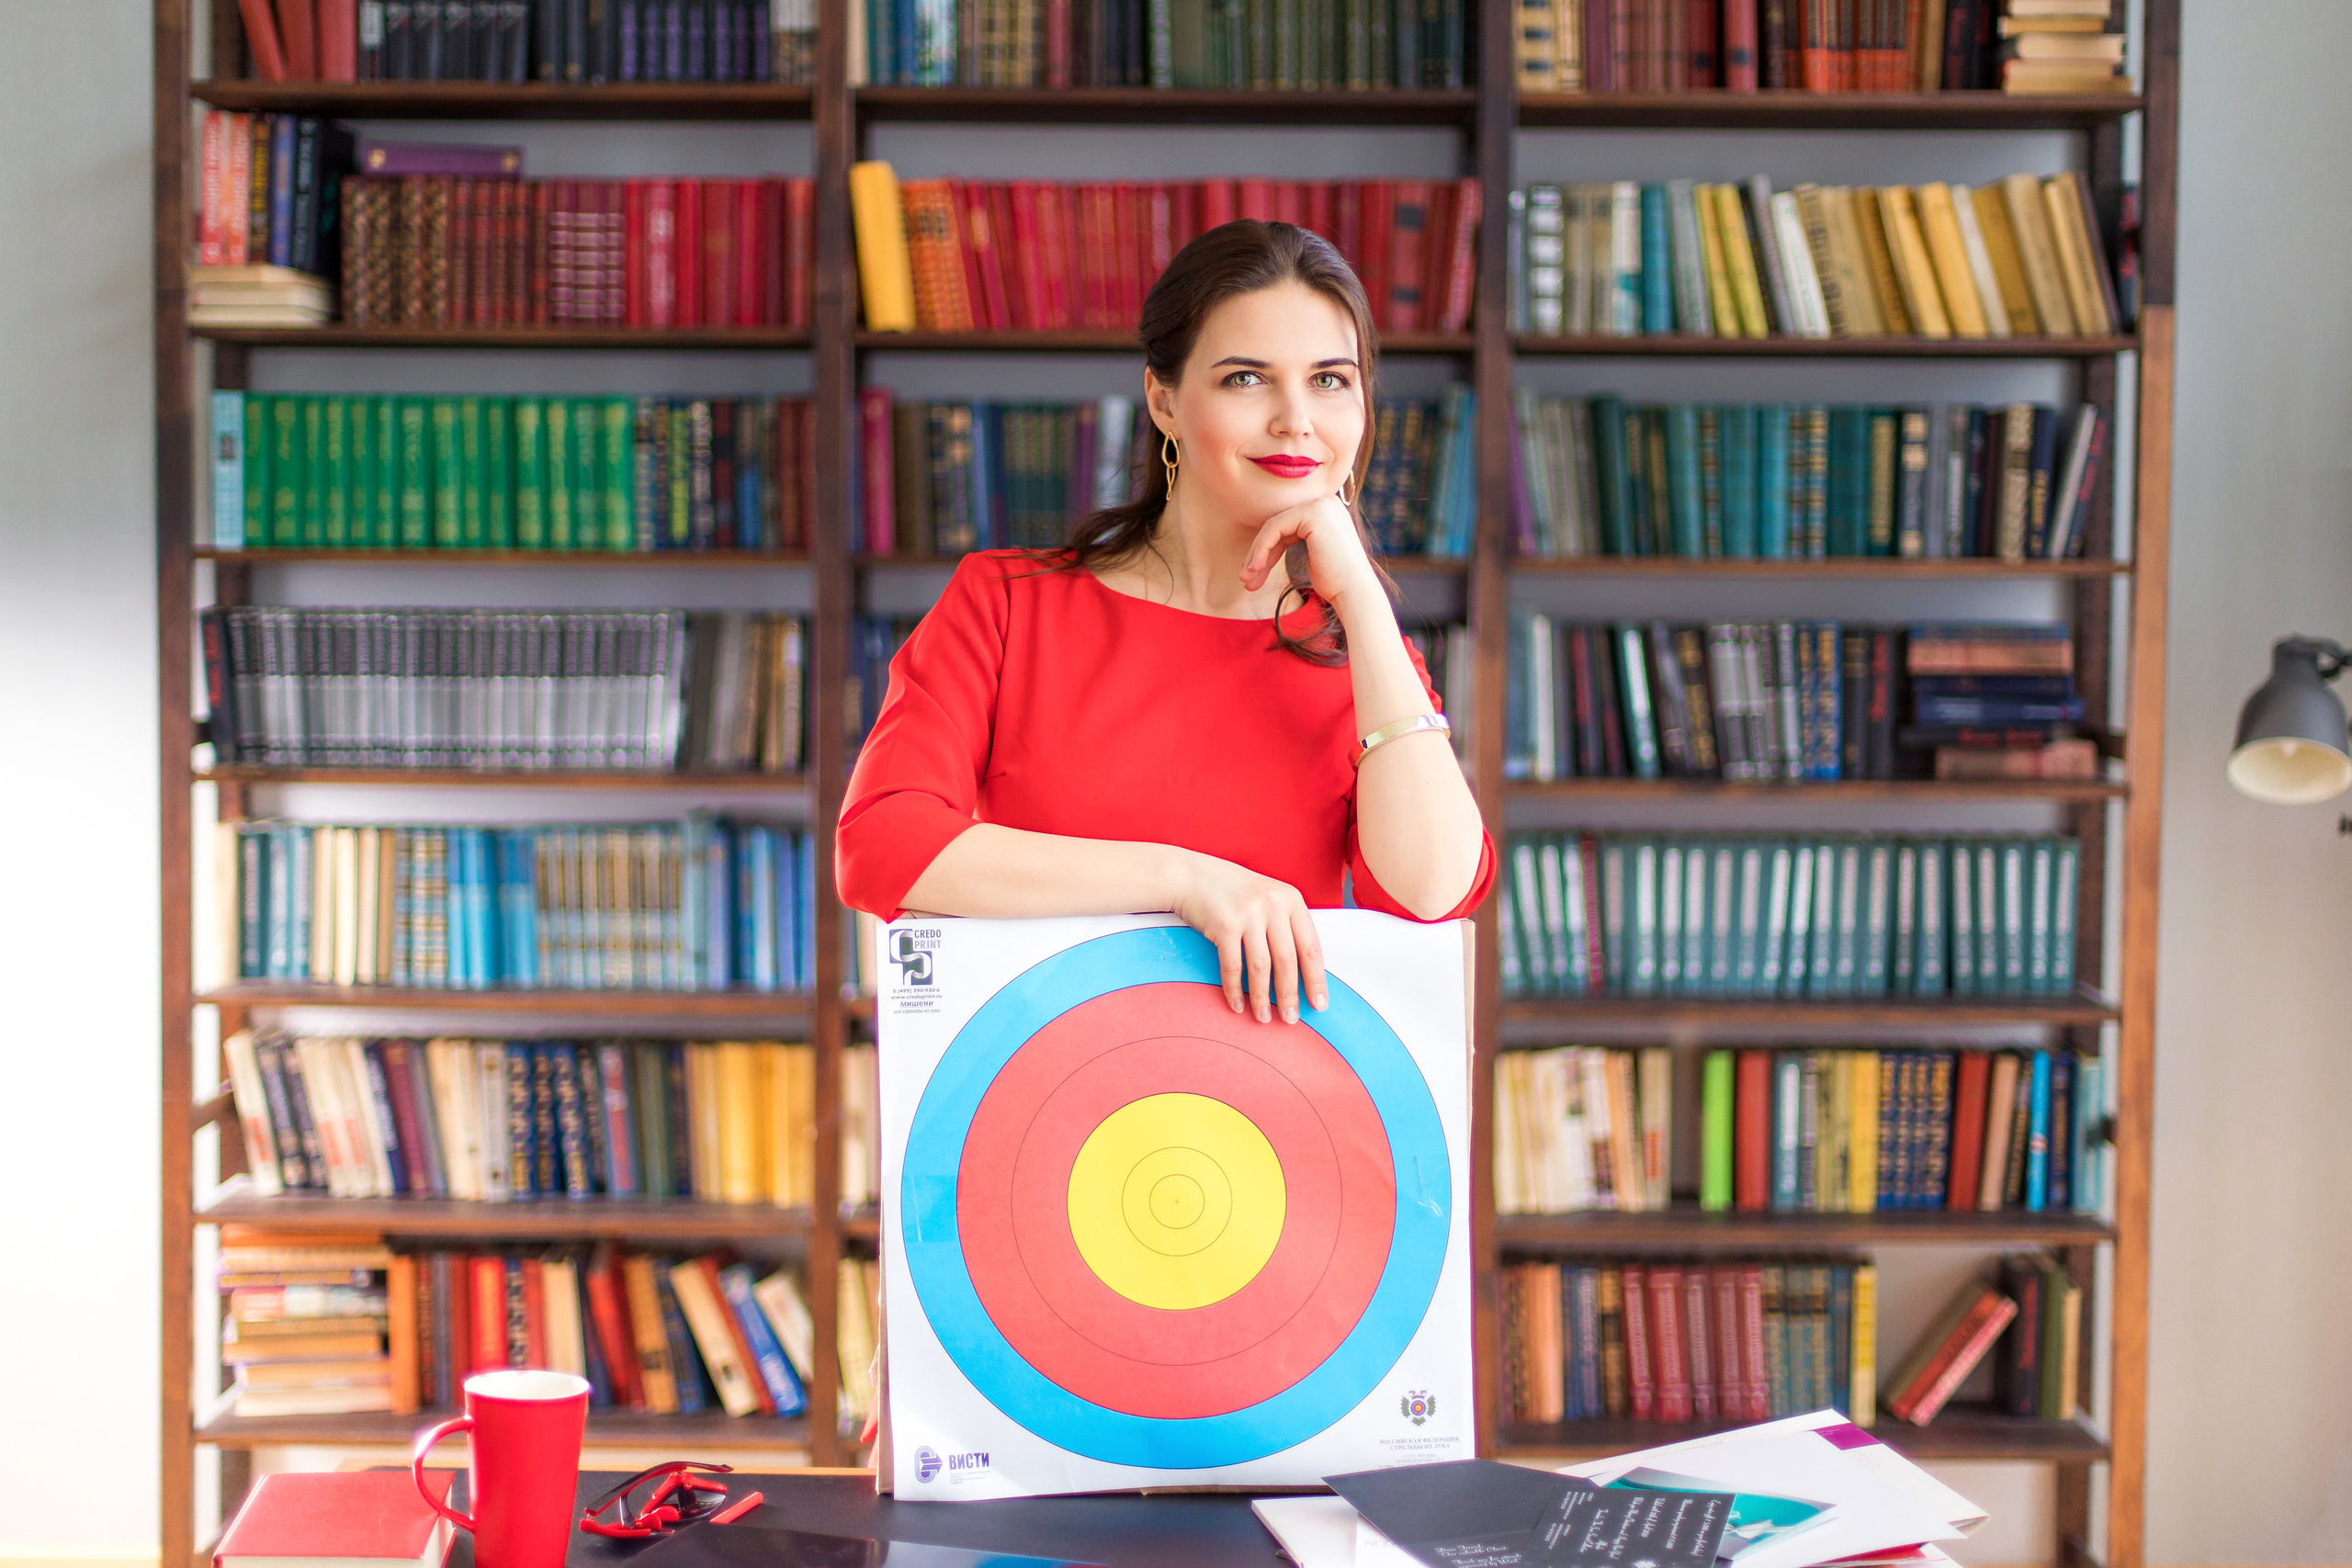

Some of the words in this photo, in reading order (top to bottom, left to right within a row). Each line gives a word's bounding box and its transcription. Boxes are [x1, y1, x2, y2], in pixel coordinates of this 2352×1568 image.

[914, 930, 942, 938] CREDO
[914, 940, 942, 949] PRINT
[948, 1452, 989, 1471] ВИСТИ
